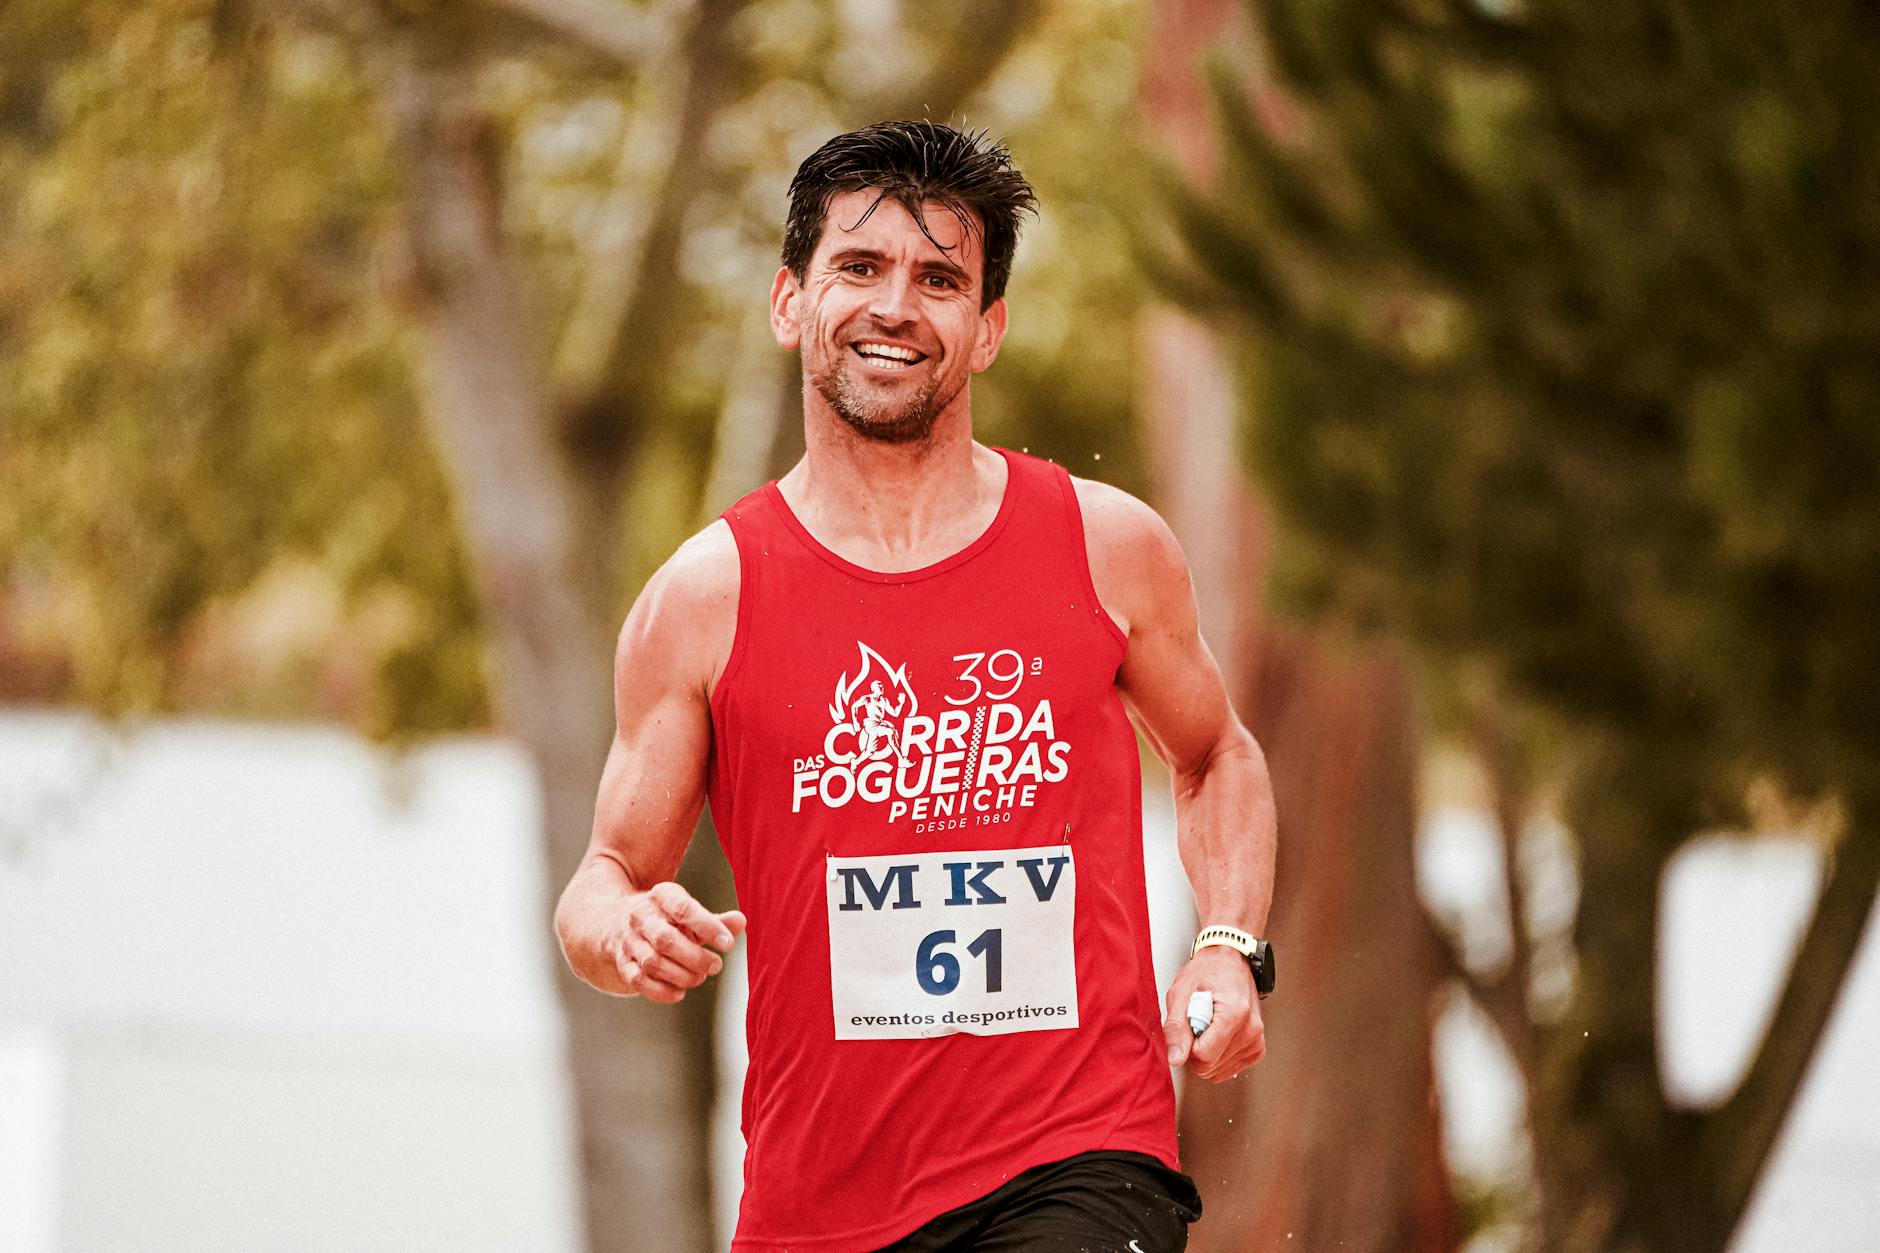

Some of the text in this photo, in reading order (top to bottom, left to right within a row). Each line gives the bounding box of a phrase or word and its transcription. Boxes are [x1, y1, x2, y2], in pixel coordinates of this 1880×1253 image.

[824, 699, 1055, 765] CORRIDA
[792, 741, 1072, 813] FOGUEIRAS
[793, 754, 825, 774] DAS
[888, 784, 1038, 823] PENICHE
[915, 812, 1011, 834] DESDE 1980
[916, 928, 1002, 996] 61
[851, 1005, 1067, 1026] eventos desportivos
